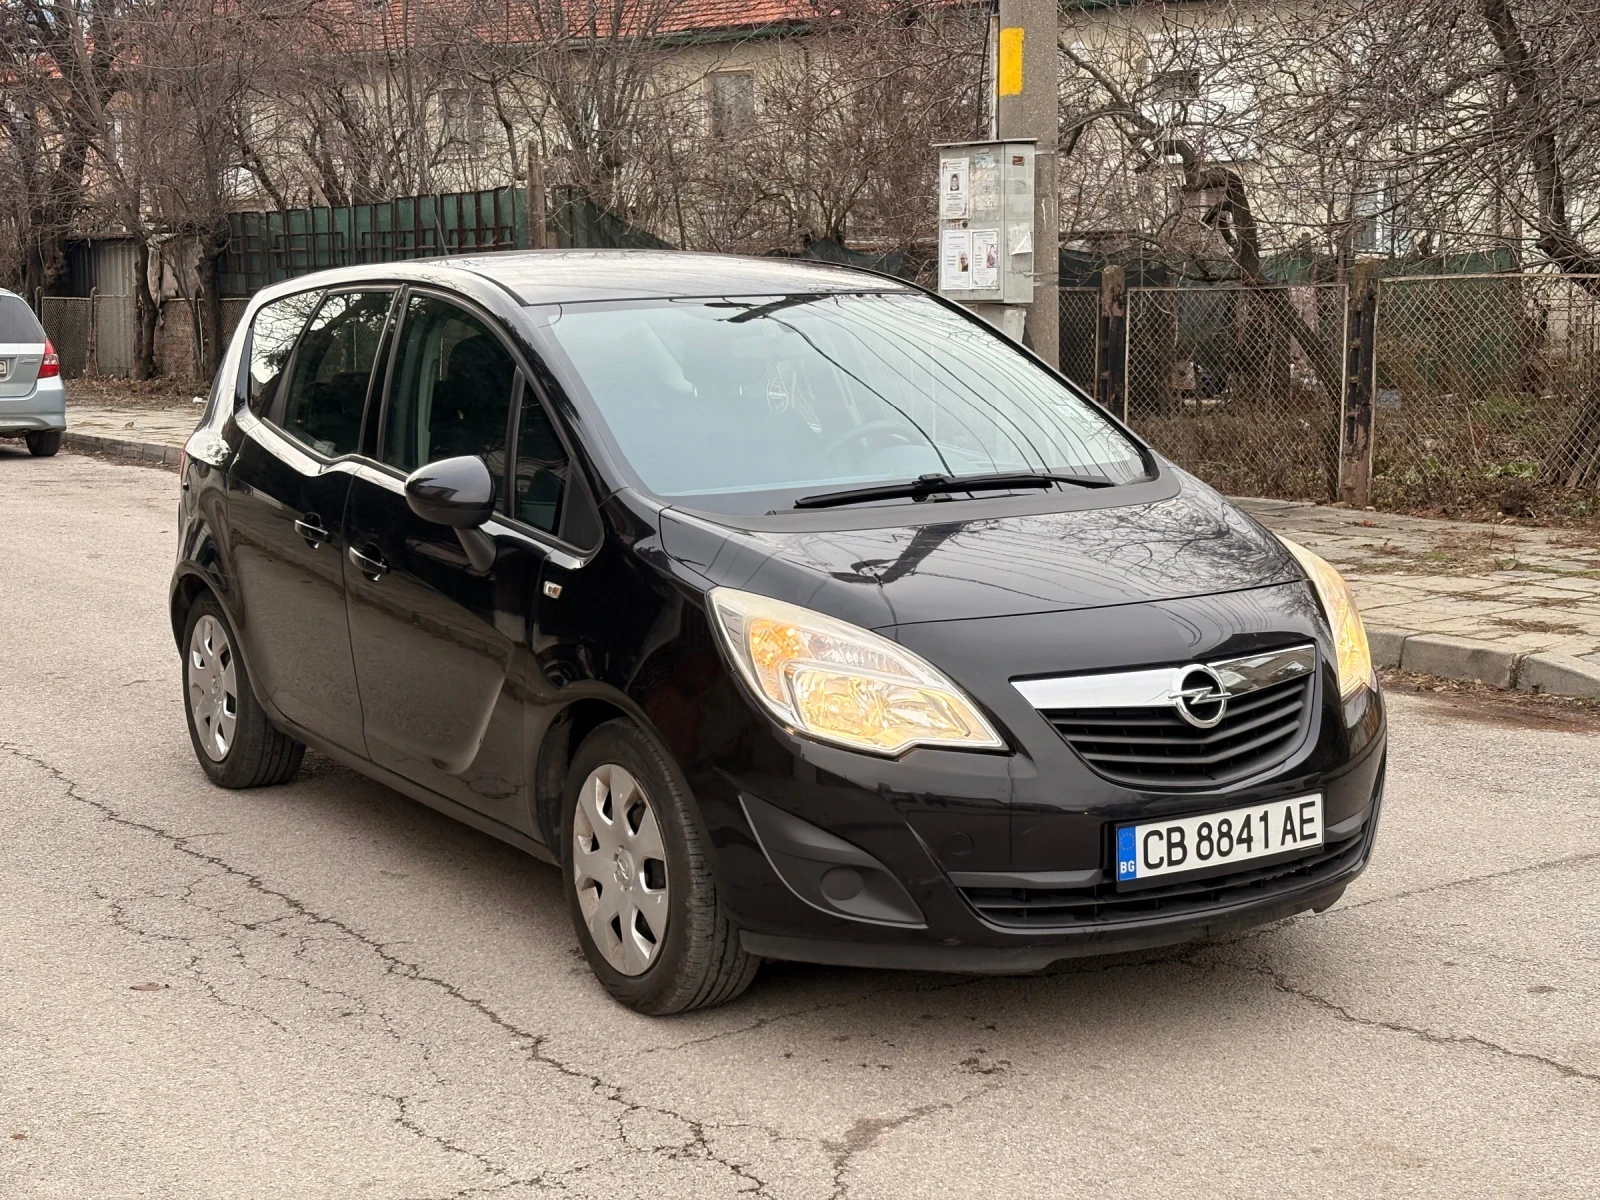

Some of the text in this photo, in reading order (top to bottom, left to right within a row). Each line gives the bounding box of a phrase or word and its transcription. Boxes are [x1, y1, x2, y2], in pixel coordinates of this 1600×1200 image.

[1143, 801, 1317, 870] CB 8841 AE
[1120, 860, 1135, 874] BG
